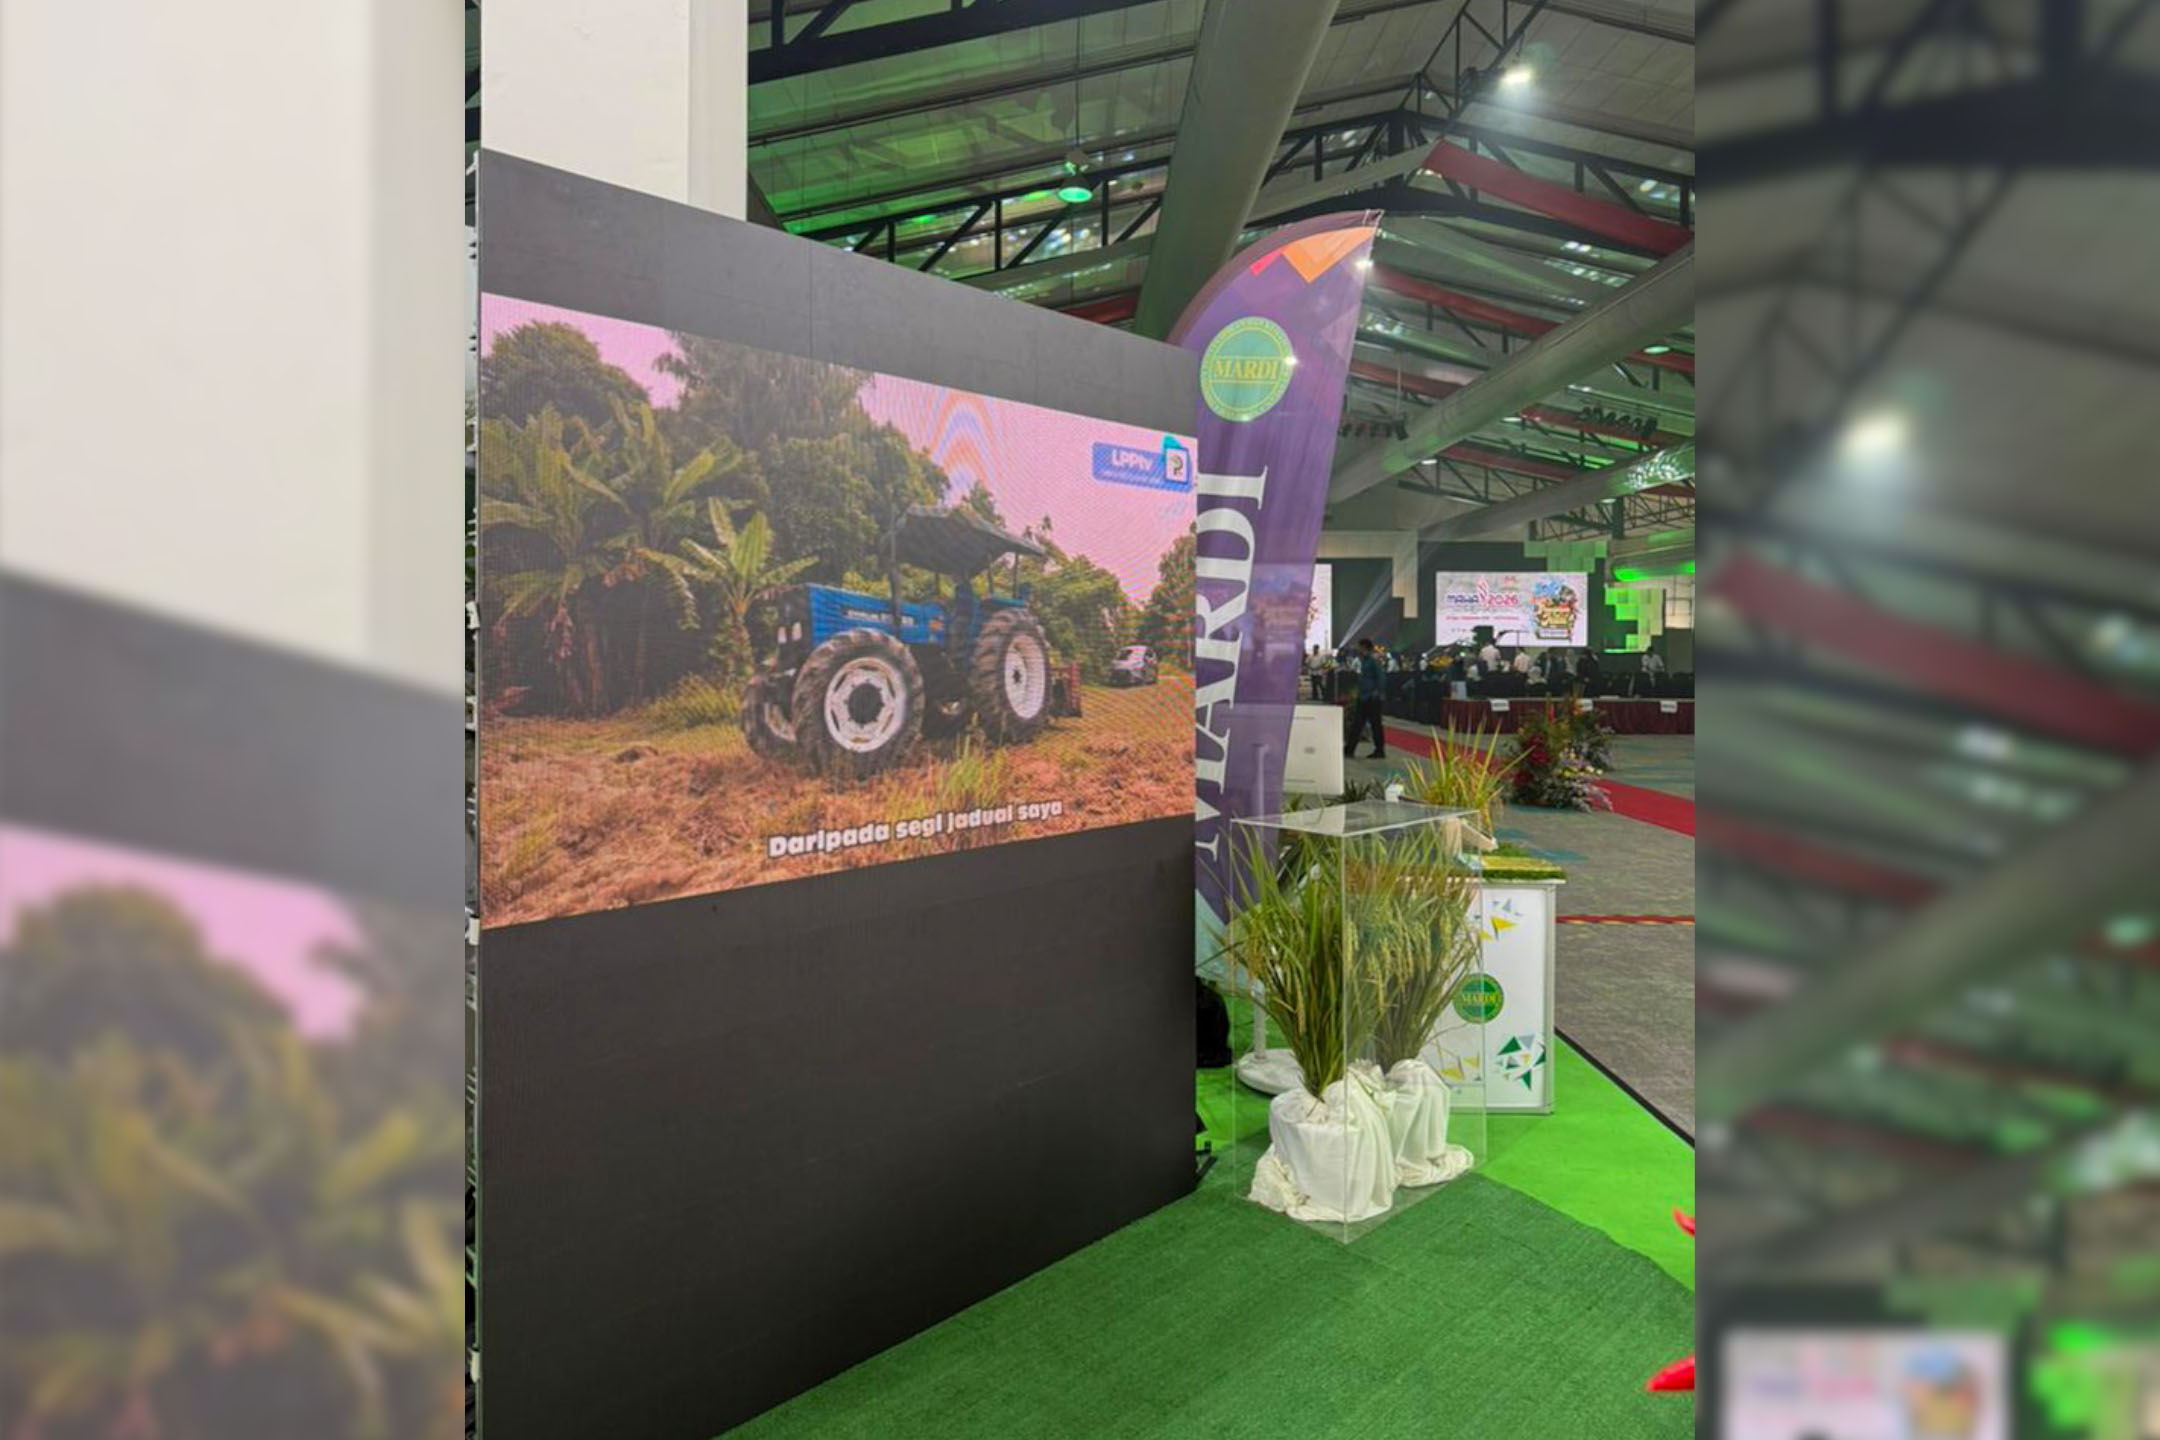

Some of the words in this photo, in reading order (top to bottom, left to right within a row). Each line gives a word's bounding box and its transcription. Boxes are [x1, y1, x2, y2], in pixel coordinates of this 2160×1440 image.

[1215, 357, 1279, 380] MARDI
[1488, 593, 1519, 607] 2026
[768, 822, 890, 857] Daripada
[895, 813, 943, 838] segi
[946, 804, 1013, 833] jadual
[1017, 800, 1063, 821] saya
